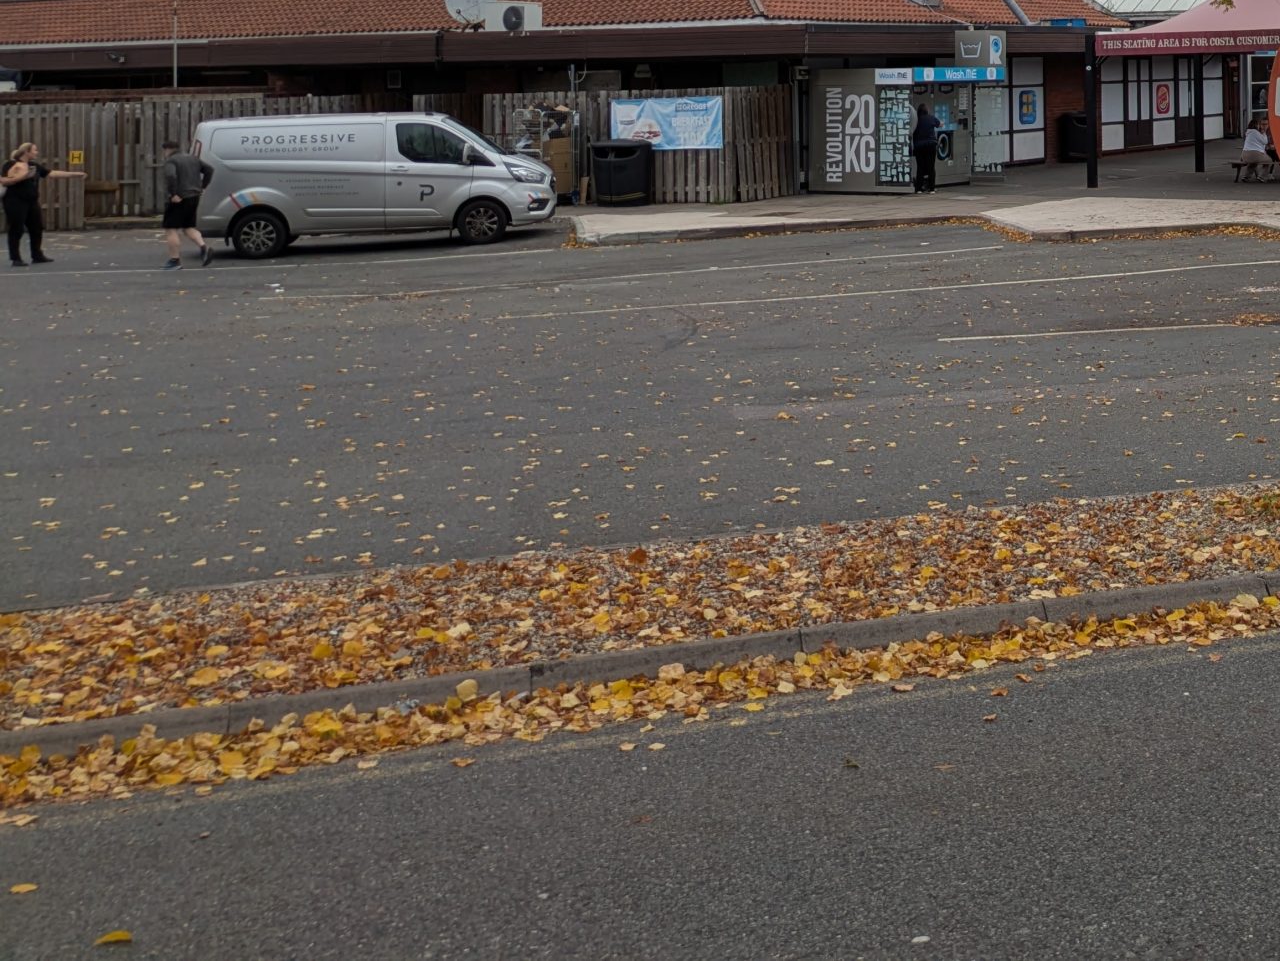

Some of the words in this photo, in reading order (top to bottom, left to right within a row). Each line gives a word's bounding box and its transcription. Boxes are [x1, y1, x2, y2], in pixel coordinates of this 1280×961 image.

[1103, 40, 1122, 50] THIS
[1123, 39, 1156, 49] SEATING
[1157, 38, 1180, 48] AREA
[1181, 38, 1190, 47] IS
[1191, 37, 1208, 47] FOR
[1209, 37, 1235, 47] COSTA
[945, 68, 977, 79] Wash.ME
[844, 94, 876, 135] 20
[240, 133, 357, 145] PROGRESSIVE
[826, 87, 843, 183] REVOLUTION
[71, 151, 82, 163] H
[844, 135, 876, 173] KG
